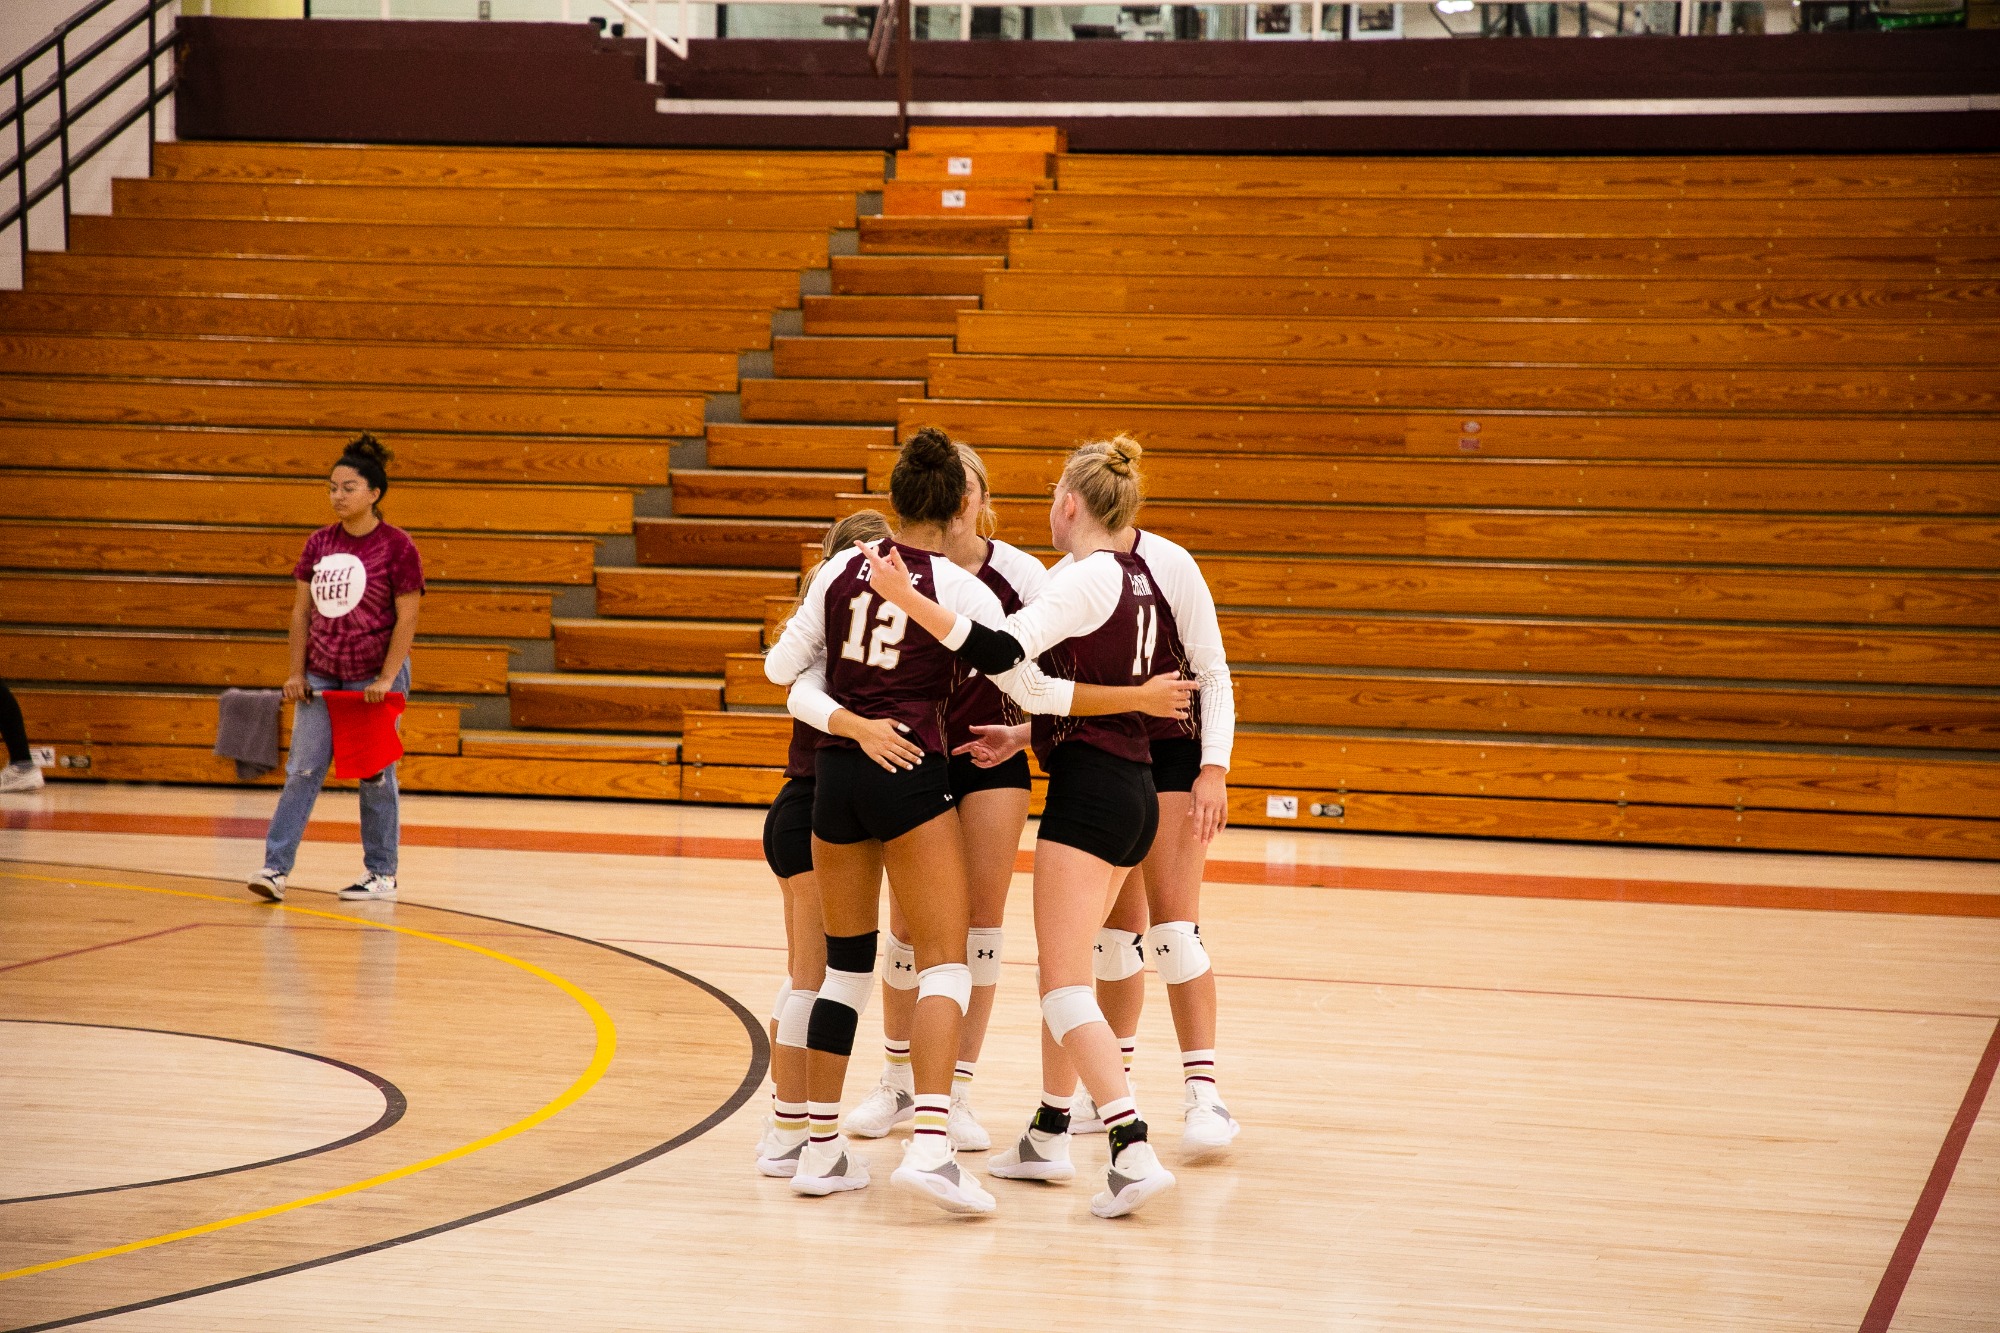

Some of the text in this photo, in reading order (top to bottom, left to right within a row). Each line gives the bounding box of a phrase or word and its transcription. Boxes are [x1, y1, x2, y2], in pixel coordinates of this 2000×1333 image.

[314, 566, 354, 584] GREET
[316, 583, 350, 601] FLEET
[841, 591, 908, 671] 12
